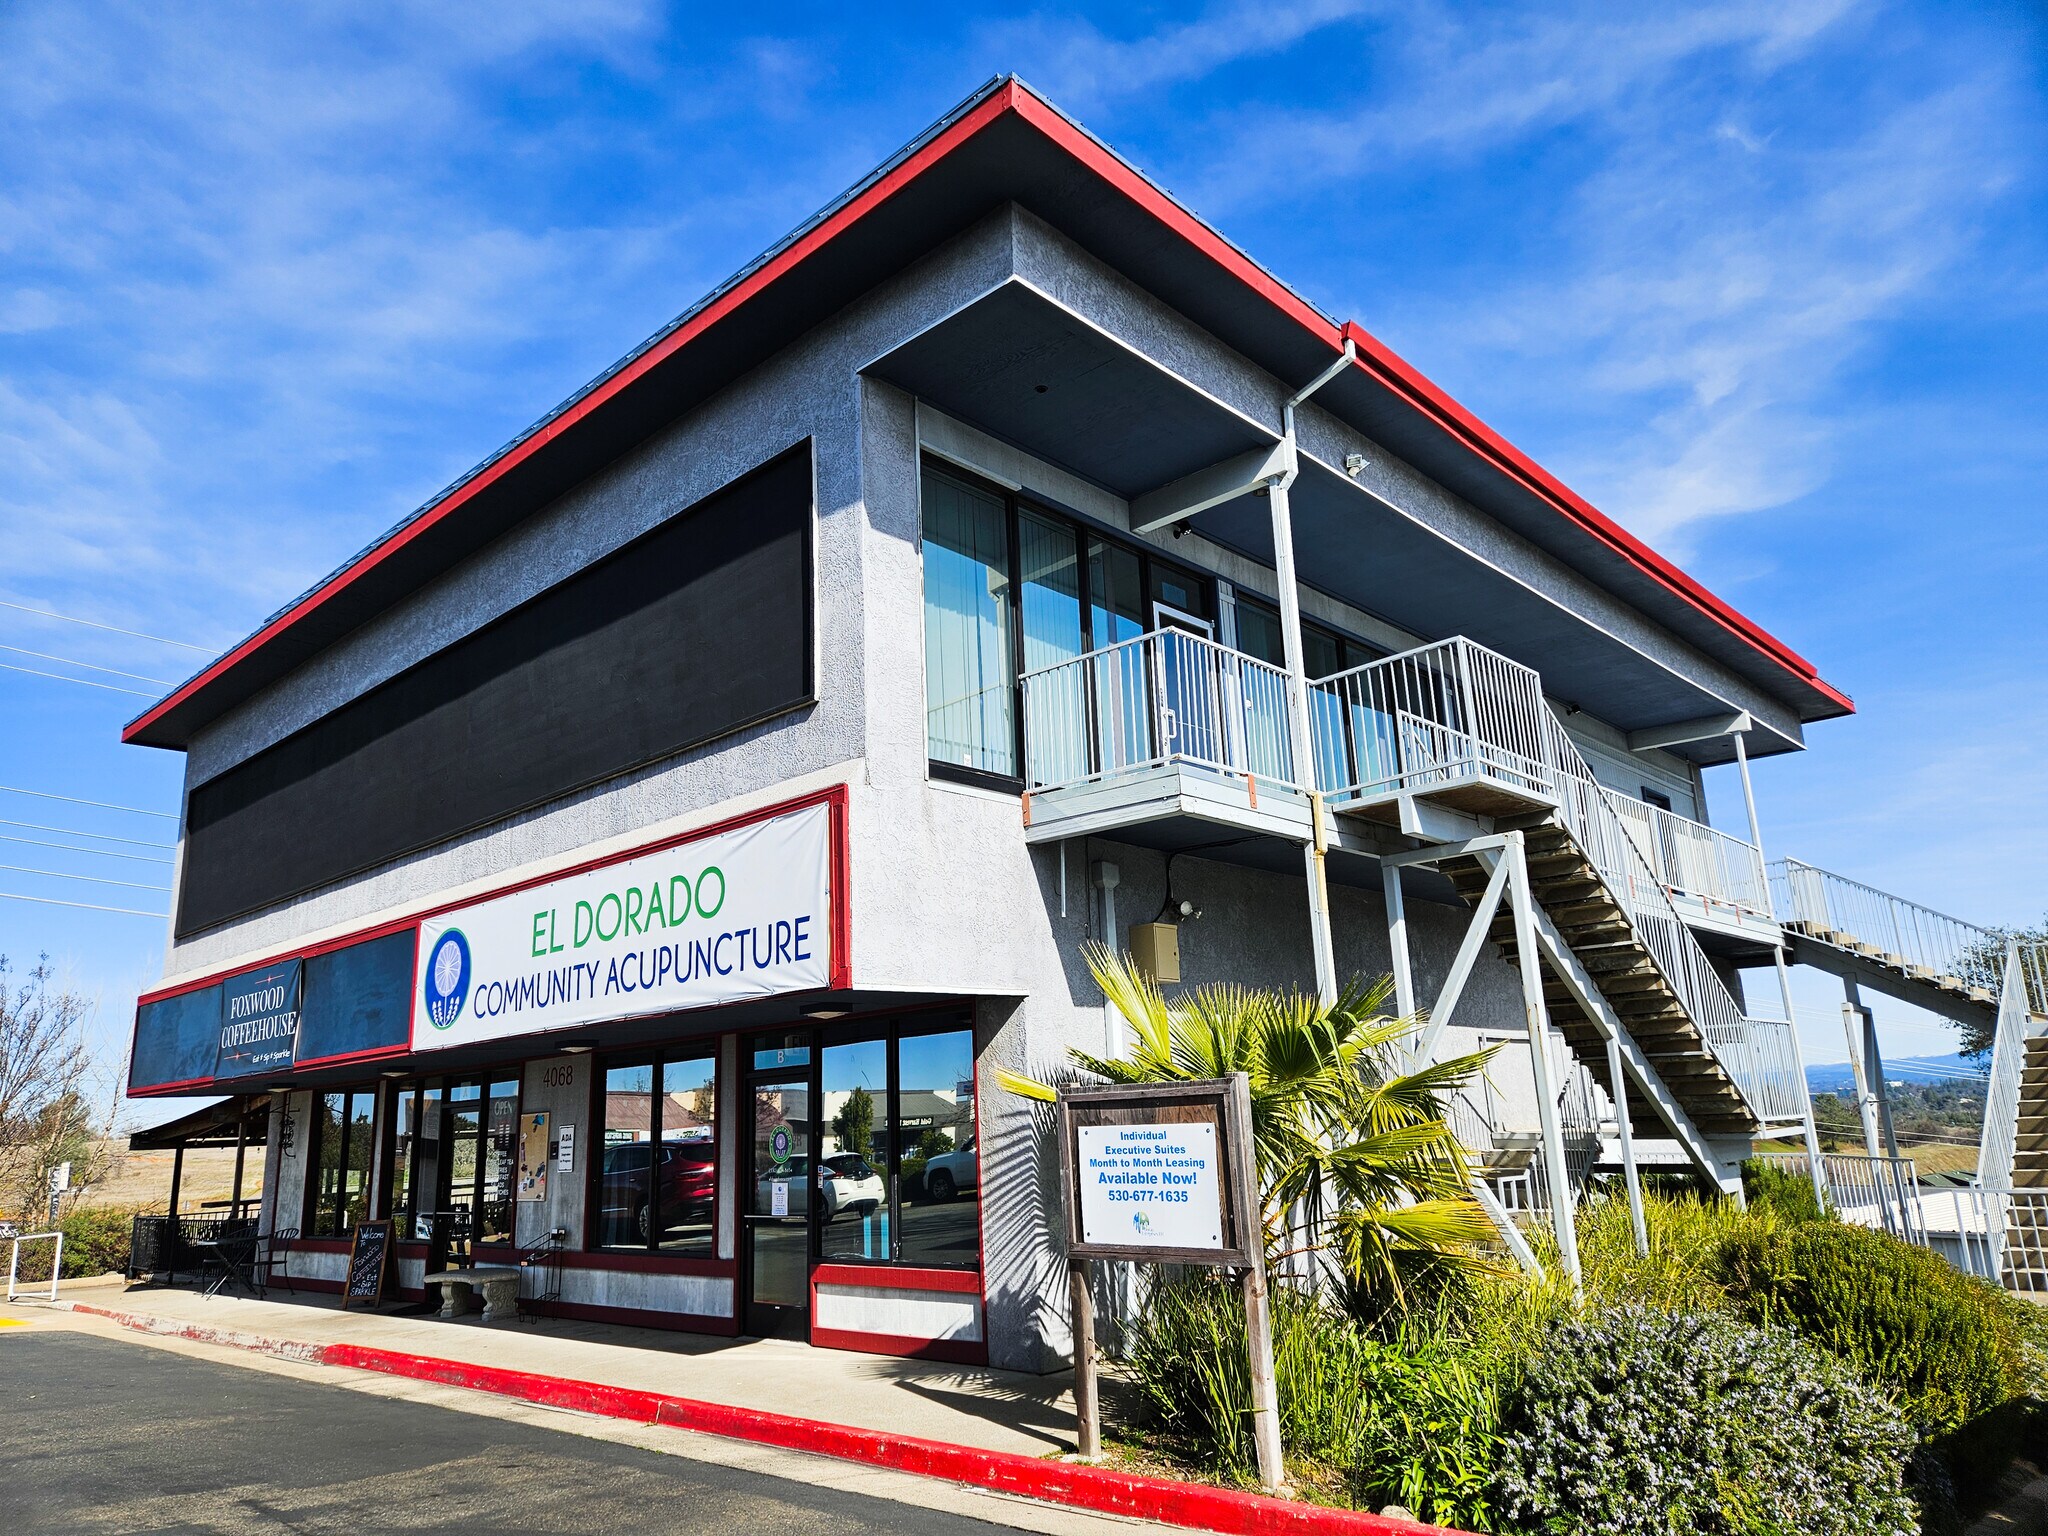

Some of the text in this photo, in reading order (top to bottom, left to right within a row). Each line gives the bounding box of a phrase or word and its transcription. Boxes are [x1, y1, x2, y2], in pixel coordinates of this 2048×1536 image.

[532, 865, 726, 958] EL DORADO
[473, 915, 811, 1019] COMMUNITY ACUPUNCTURE
[230, 985, 284, 1020] FOXWOOD
[221, 1011, 297, 1049] COFFEEHOUSE
[777, 1050, 785, 1064] B
[543, 1065, 573, 1088] 4068
[494, 1100, 513, 1116] OPEN
[561, 1133, 573, 1142] ADA
[1120, 1131, 1167, 1141] Individual
[1105, 1145, 1186, 1155] Executive Suites
[1089, 1158, 1205, 1169] Month to Month Leasing
[1098, 1172, 1197, 1184] Available Now!
[1108, 1190, 1188, 1202] 530-677-1635
